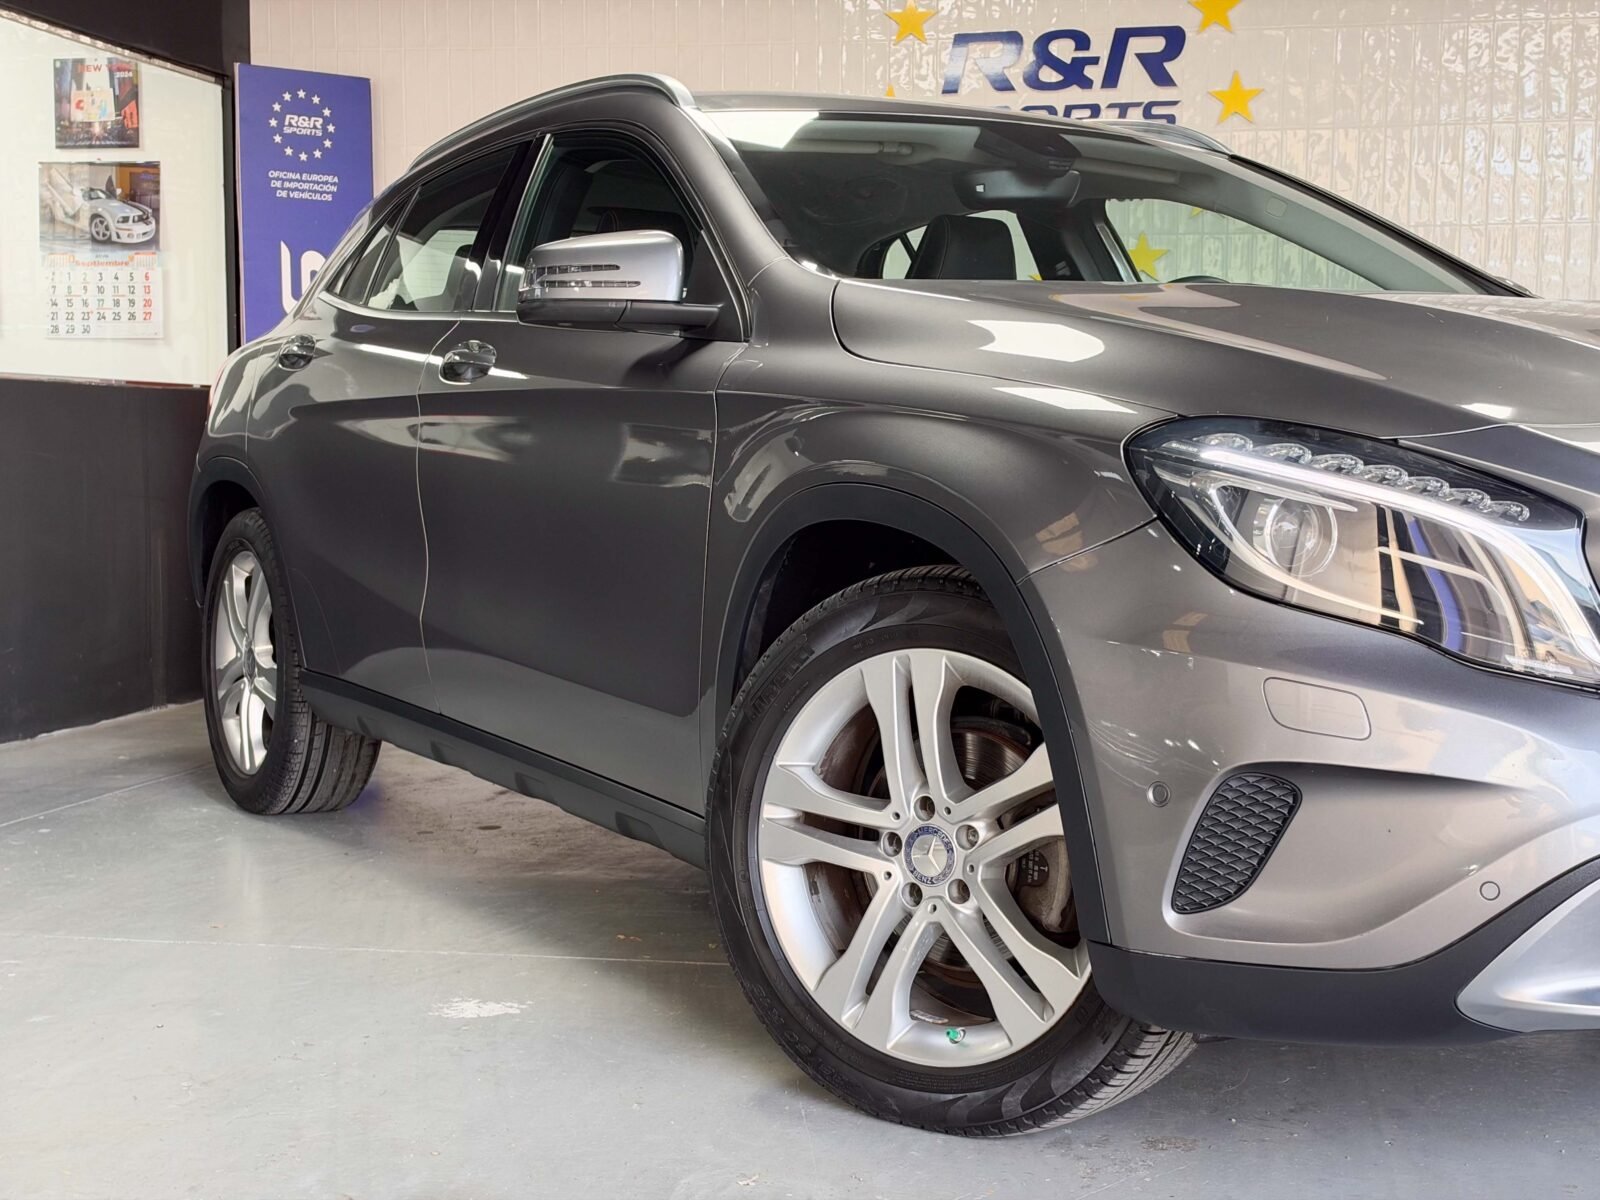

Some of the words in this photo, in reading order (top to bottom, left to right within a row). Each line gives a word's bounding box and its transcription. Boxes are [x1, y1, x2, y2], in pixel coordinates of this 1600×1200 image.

[941, 25, 1186, 94] R&R
[284, 114, 324, 129] R&R
[283, 127, 323, 137] SPORTS
[268, 170, 301, 181] OFICINA
[302, 173, 338, 183] EUROPEA
[271, 180, 282, 189] DE
[283, 181, 337, 192] IMPORTACIÓN
[276, 190, 288, 198] DE
[289, 190, 333, 201] VEHÍCULOS
[97, 272, 103, 282] 3
[113, 272, 119, 282] 4
[129, 272, 134, 282] 5
[144, 272, 150, 282] 6
[50, 285, 56, 295] 7
[82, 285, 88, 295] 9
[97, 285, 105, 295] 10
[112, 285, 119, 295] 11
[128, 285, 135, 295] 12
[143, 285, 151, 295] 13
[50, 298, 58, 308] 14
[66, 298, 74, 308] 15
[81, 298, 89, 308] 16
[97, 298, 105, 308] 17
[112, 298, 121, 308] 18
[128, 298, 136, 308] 19
[143, 298, 152, 308] 20
[50, 312, 58, 321] 21
[65, 312, 74, 321] 22
[81, 312, 90, 321] 23
[96, 312, 106, 321] 24
[112, 312, 121, 321] 25
[128, 312, 137, 321] 26
[143, 312, 152, 321] 27
[50, 324, 60, 334] 28
[65, 324, 75, 334] 29
[81, 324, 91, 334] 30
[912, 870, 932, 884] BENZ
